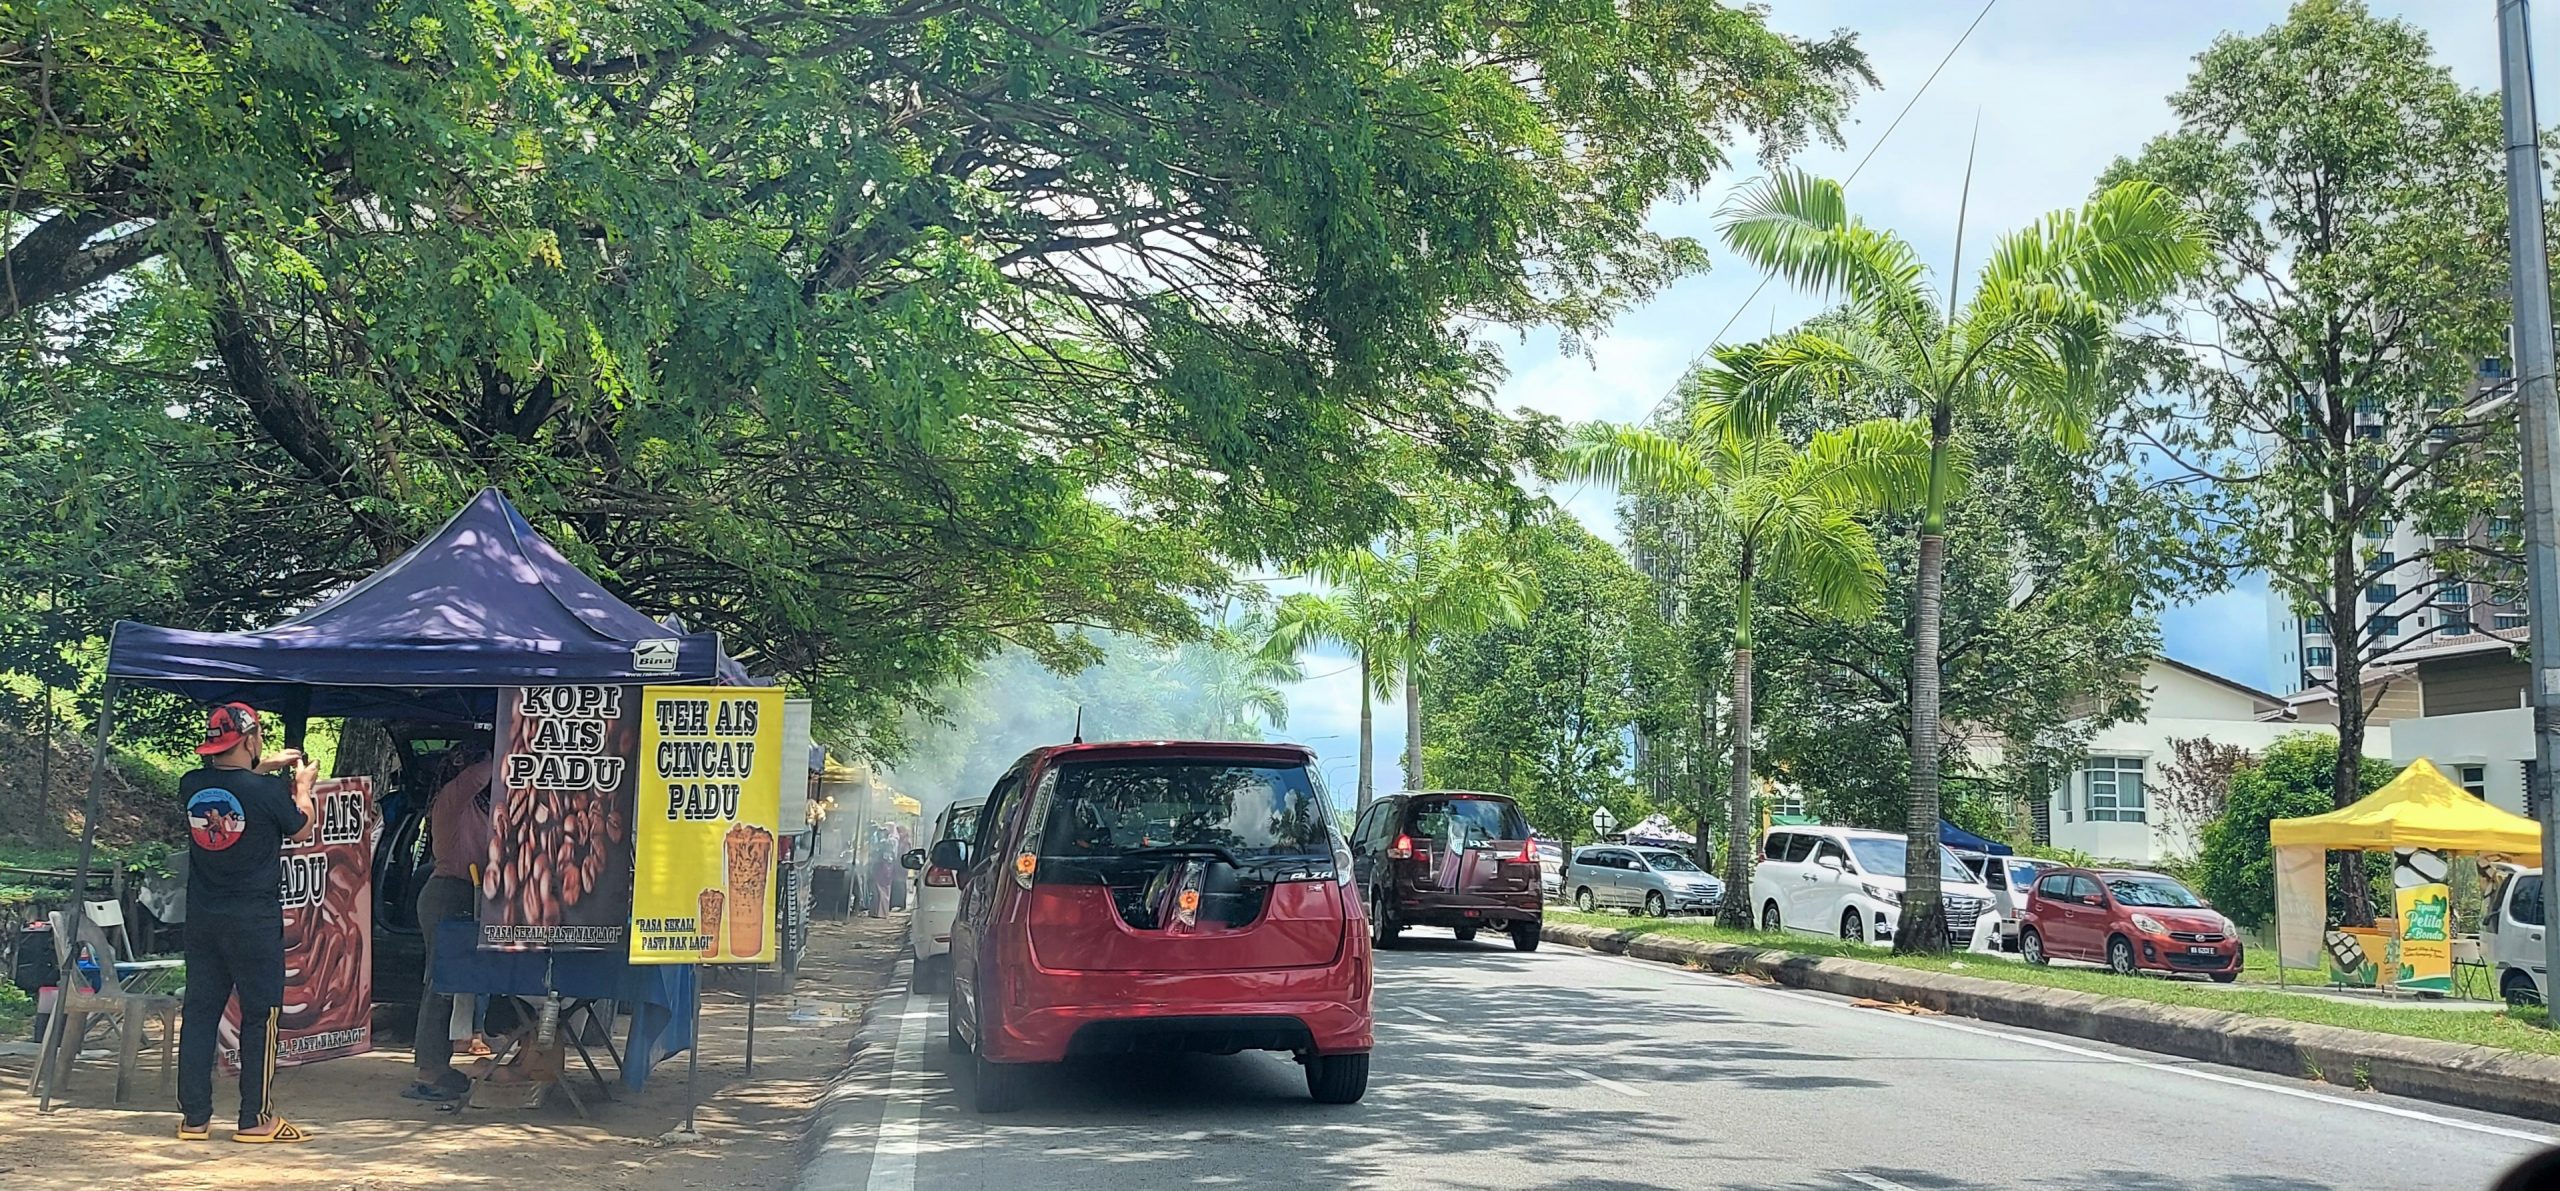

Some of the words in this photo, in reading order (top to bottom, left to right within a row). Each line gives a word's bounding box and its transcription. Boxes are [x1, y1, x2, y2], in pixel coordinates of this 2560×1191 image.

[639, 657, 673, 665] Bina
[521, 685, 621, 717] KOPI
[656, 700, 709, 736] TEH
[715, 700, 758, 736] AIS
[533, 720, 603, 752] AIS
[508, 756, 623, 790] PADU
[656, 741, 755, 778] CINCAU
[322, 791, 363, 842] AIS
[667, 784, 740, 820] PADU
[280, 856, 327, 906] ADU
[1290, 871, 1333, 880] ALZA
[548, 927, 575, 942] PASTI
[576, 927, 596, 942] NAK
[642, 936, 667, 951] PASTI
[669, 936, 687, 951] NAK
[2411, 927, 2443, 940] Bonda
